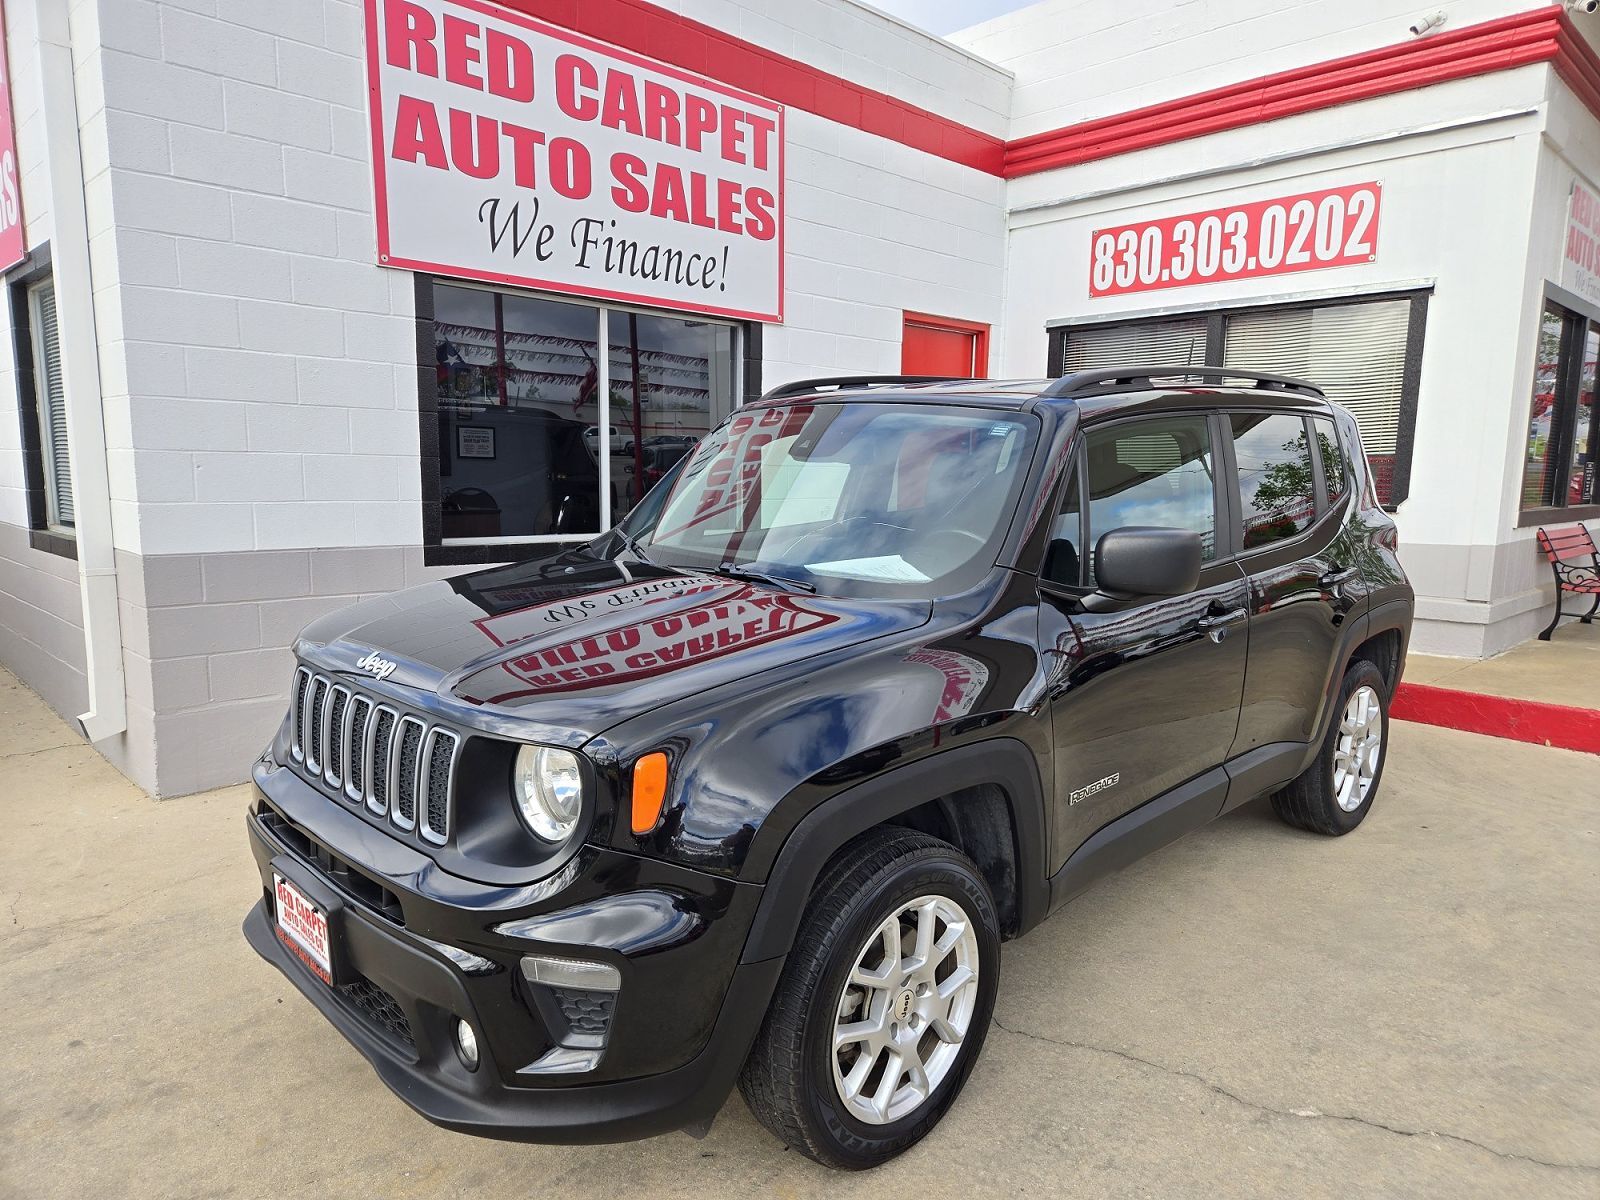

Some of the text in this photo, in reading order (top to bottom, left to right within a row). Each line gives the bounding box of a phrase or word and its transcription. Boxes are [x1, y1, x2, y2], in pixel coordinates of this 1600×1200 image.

[384, 0, 775, 171] RED CARPET
[391, 94, 776, 241] AUTO SALES
[478, 197, 730, 292] We Finance!
[1093, 189, 1376, 291] 830.303.0202
[1566, 225, 1594, 272] AUTO
[356, 650, 397, 680] Jeep
[1069, 772, 1120, 806] RENEGADE
[277, 881, 294, 910] RED
[295, 897, 328, 941] CARPET
